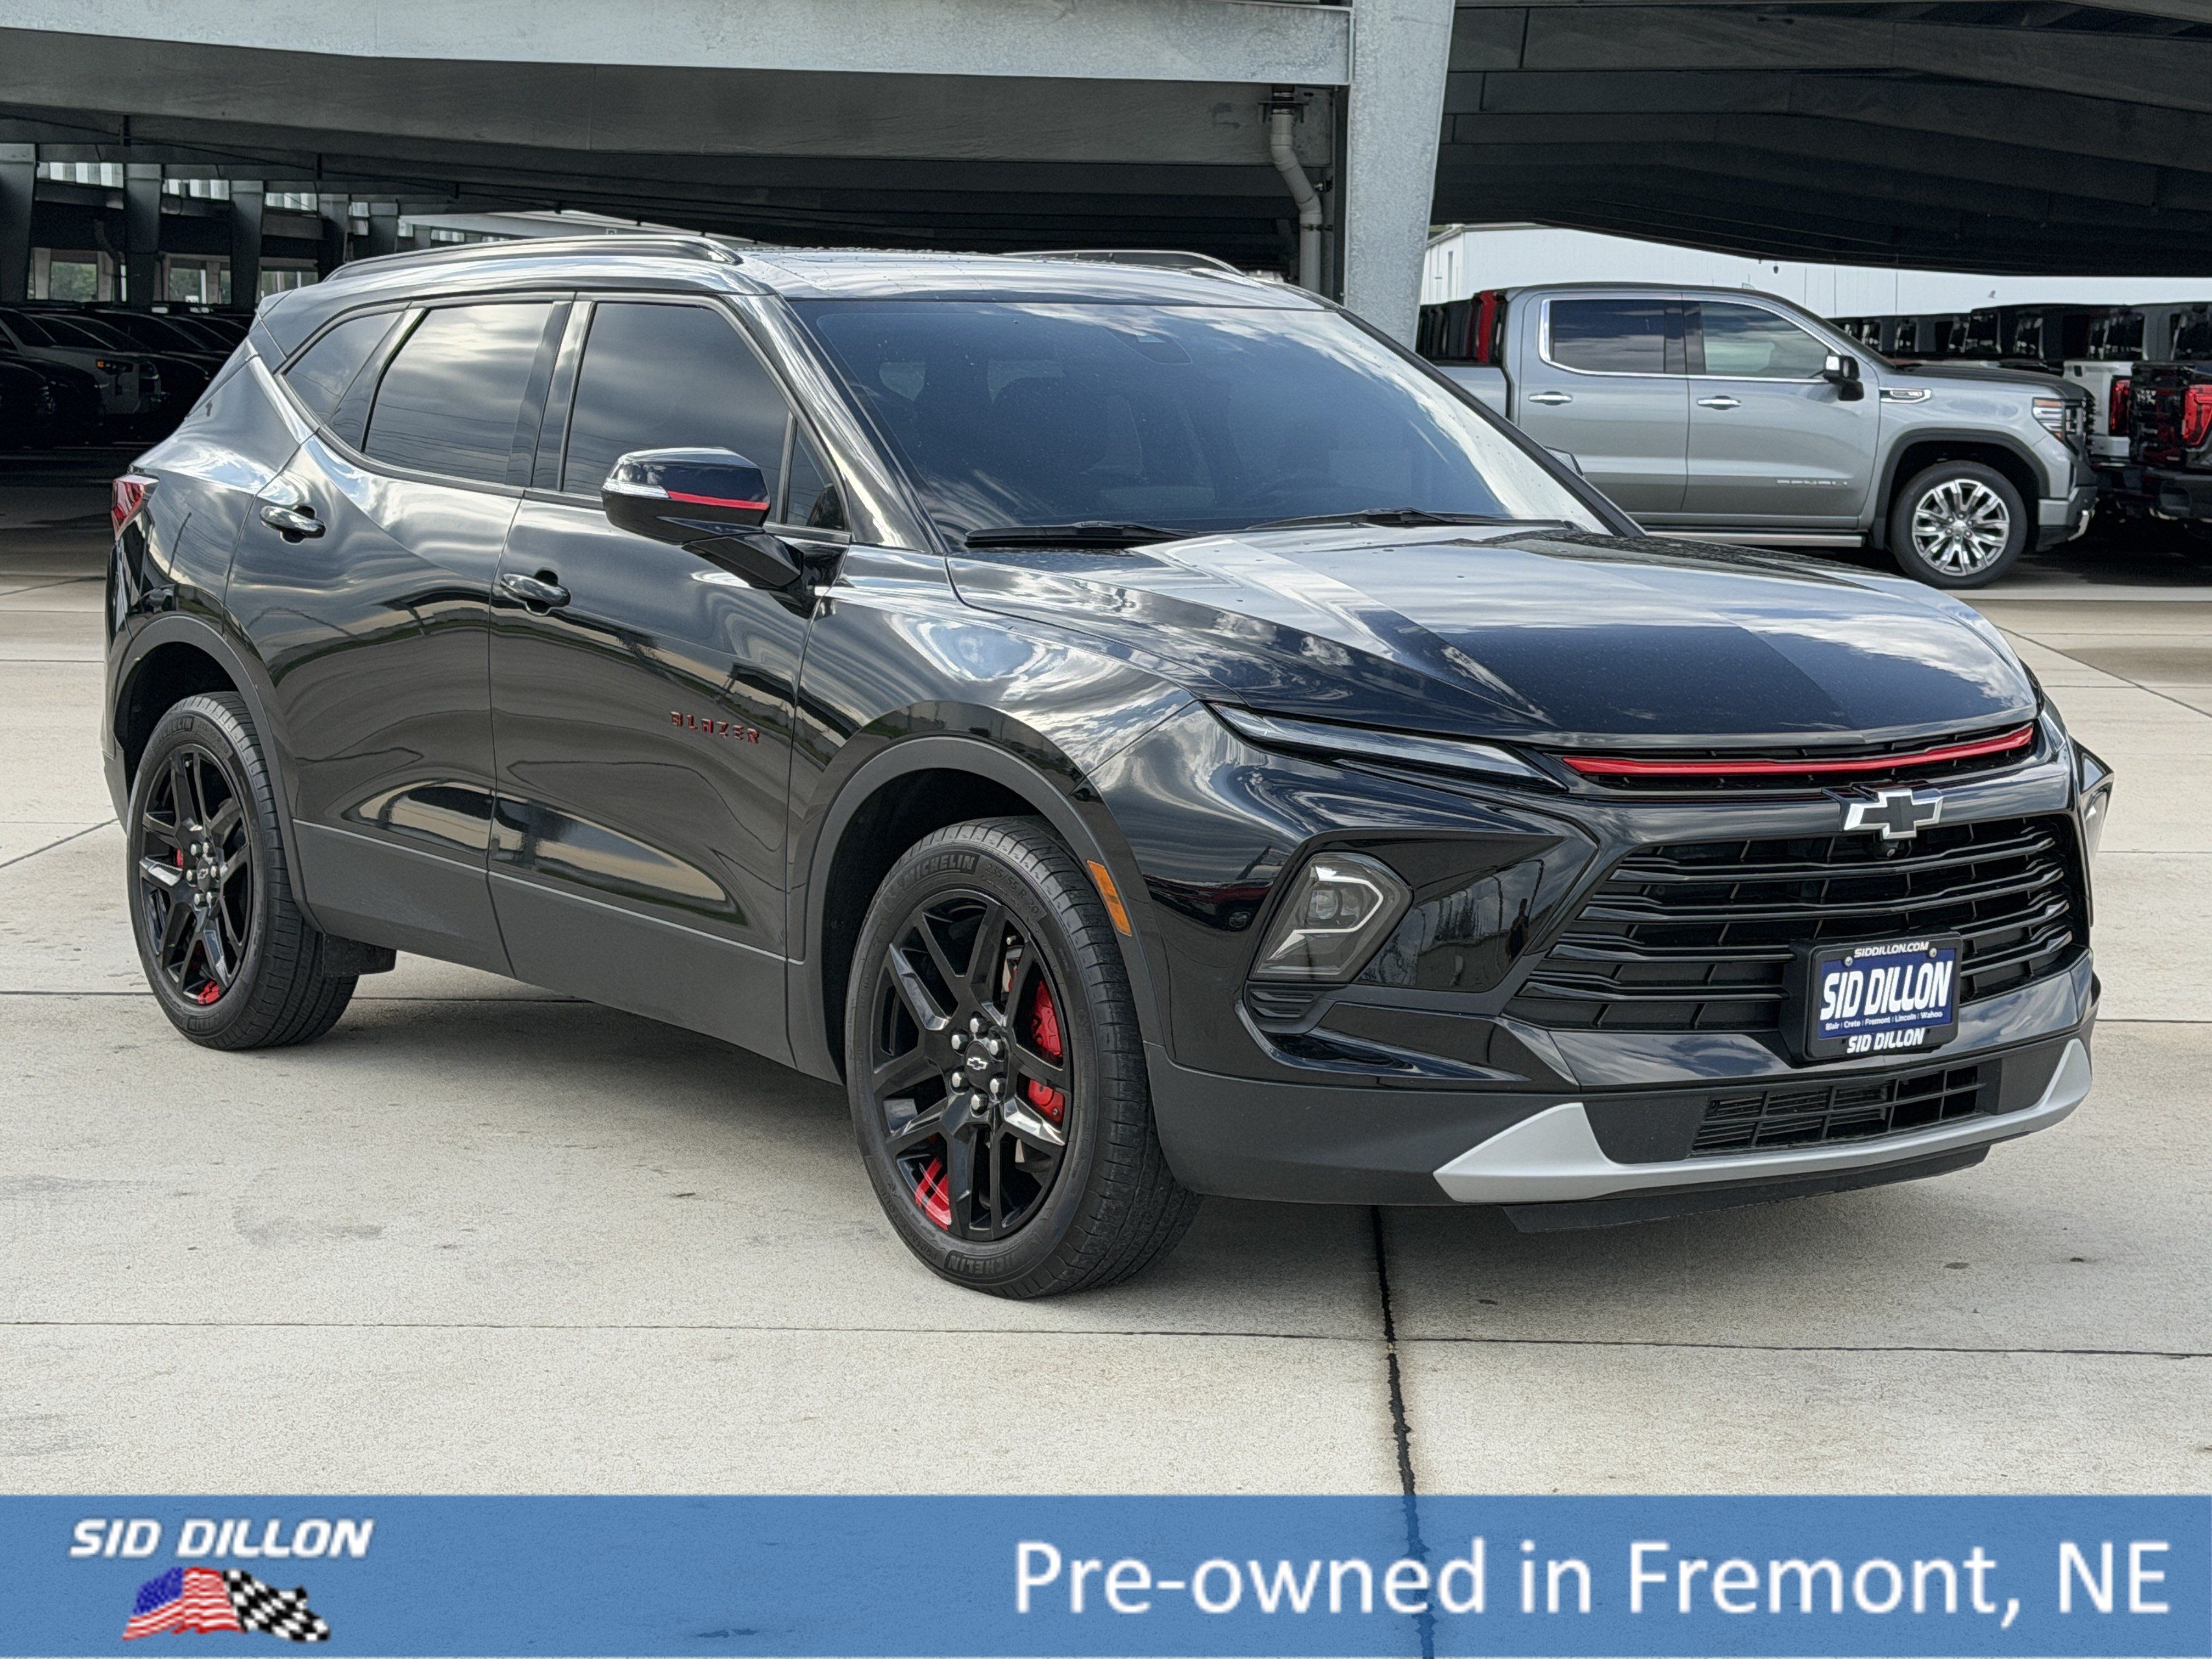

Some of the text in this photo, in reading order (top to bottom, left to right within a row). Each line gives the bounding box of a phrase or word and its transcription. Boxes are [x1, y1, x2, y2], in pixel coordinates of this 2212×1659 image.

[670, 711, 760, 744] BLAZER
[1854, 941, 1929, 958] SIDDILLON.COM
[1820, 960, 1953, 1020] SID DILLON
[1921, 1011, 1943, 1019] Wahoo
[1847, 1027, 1926, 1054] SID DILLON
